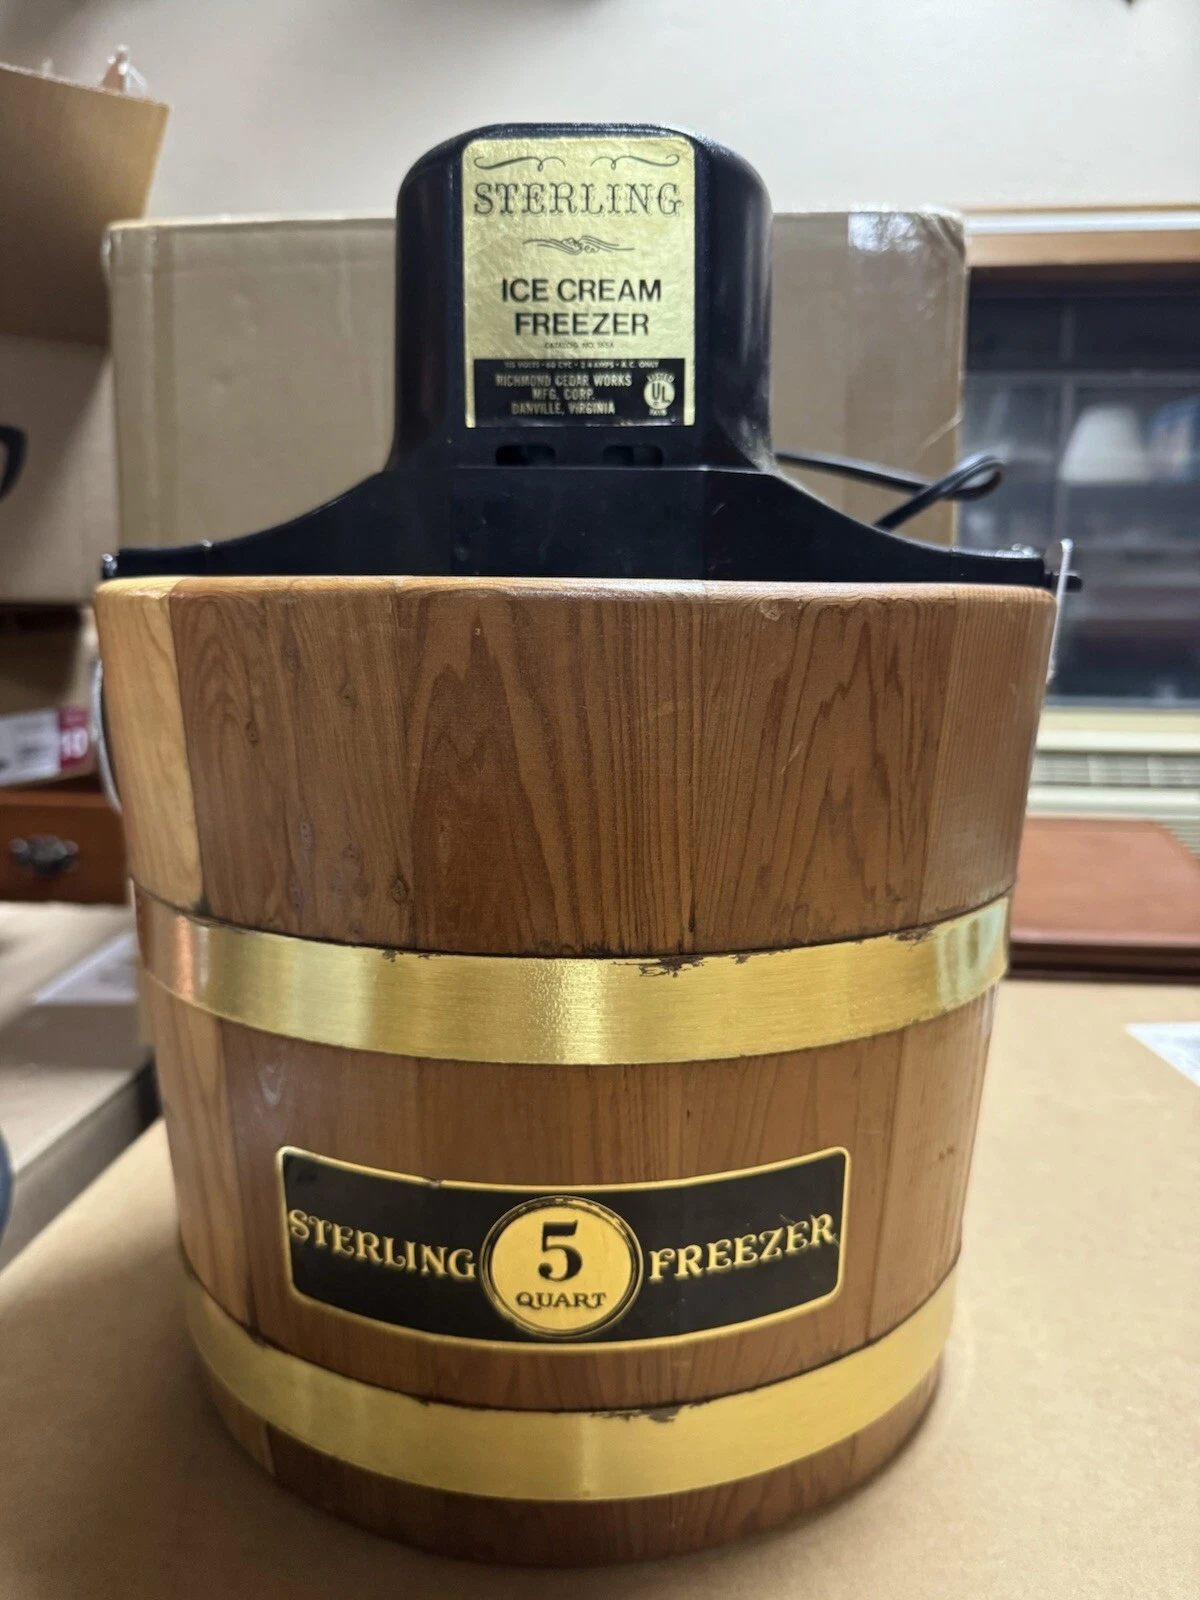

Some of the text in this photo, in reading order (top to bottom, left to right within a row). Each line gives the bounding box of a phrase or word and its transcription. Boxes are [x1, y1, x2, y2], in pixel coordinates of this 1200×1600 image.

[474, 182, 684, 217] STERLING
[502, 278, 662, 301] ICE CREAM
[514, 312, 649, 336] FREEZER
[638, 361, 659, 369] ONLY
[495, 372, 632, 387] RICHMOND CEDAR WORKS
[531, 387, 595, 400] MFG. CORP.
[652, 382, 671, 402] UL
[511, 401, 616, 416] DANVILLE, VIRGINIA
[288, 1208, 478, 1280] STERLING
[537, 1219, 583, 1282] 5
[649, 1212, 836, 1281] FREEZER
[515, 1292, 607, 1311] QUART
